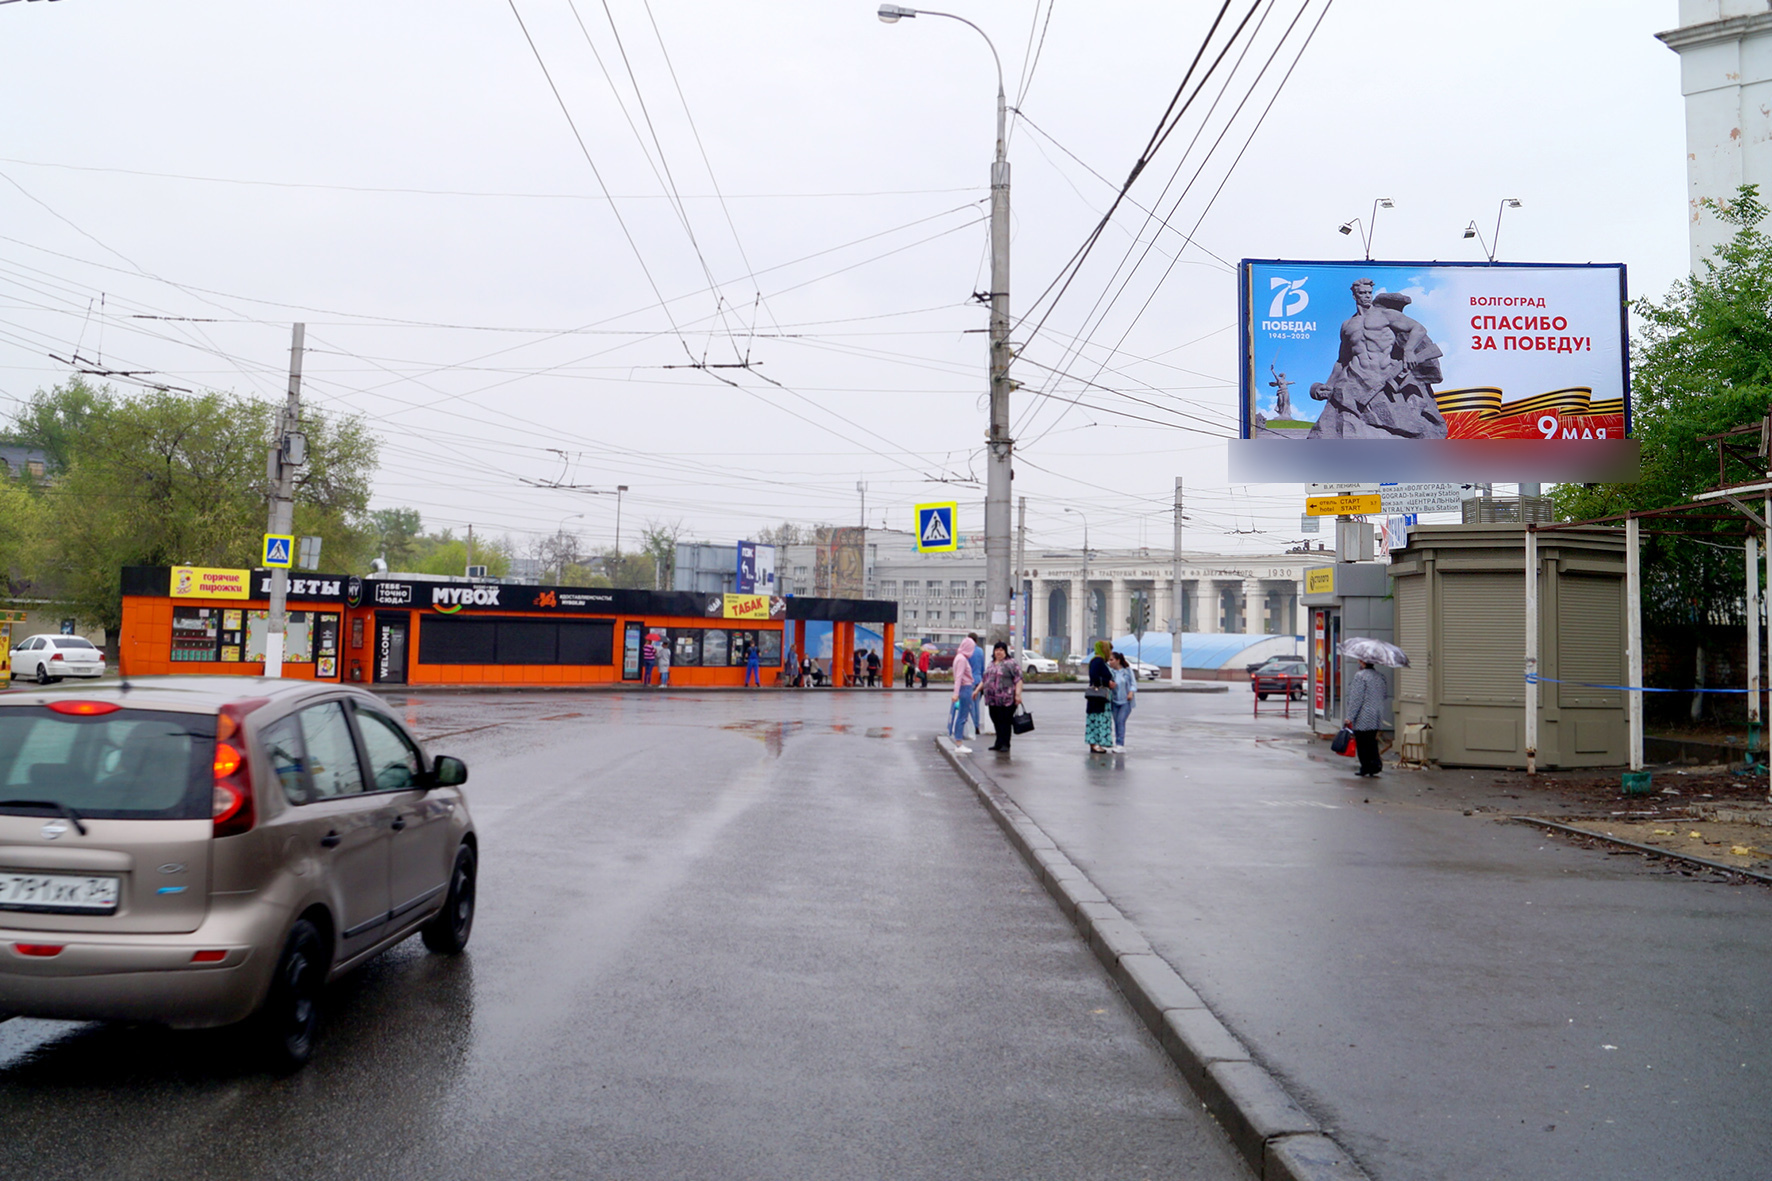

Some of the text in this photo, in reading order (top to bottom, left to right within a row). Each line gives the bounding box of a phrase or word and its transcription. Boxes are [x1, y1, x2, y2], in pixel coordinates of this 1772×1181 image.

[1269, 276, 1309, 317] 75
[1470, 296, 1546, 308] ВОЛГОГРАД
[1262, 320, 1316, 332] ПОБЕДА!
[1470, 315, 1567, 331] СПАСИБО
[1471, 335, 1591, 354] ЗА ПОБЕДУ!
[1537, 415, 1607, 440] 9 МАЯ
[1414, 490, 1437, 499] Railway
[203, 574, 240, 583] горячие
[1268, 568, 1292, 577] 1930
[199, 583, 243, 594] пирожки
[348, 585, 360, 596] MY
[432, 587, 500, 606] MYBOX
[731, 597, 763, 617] ТАБАК
[380, 626, 391, 678] WELCOME
